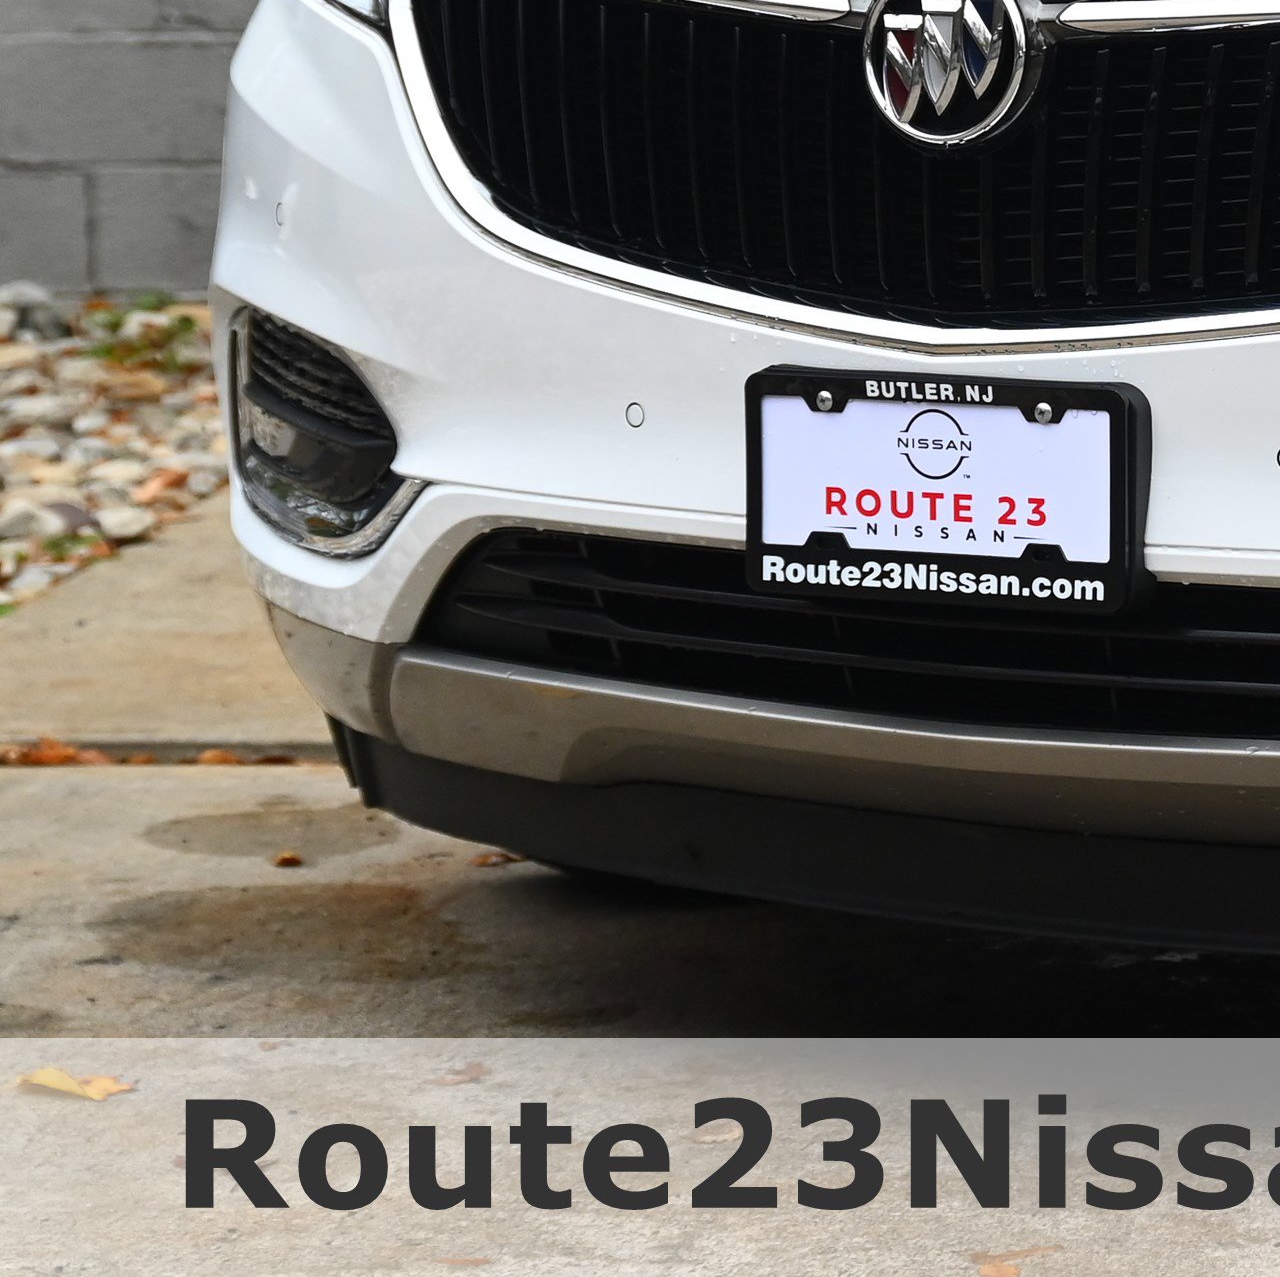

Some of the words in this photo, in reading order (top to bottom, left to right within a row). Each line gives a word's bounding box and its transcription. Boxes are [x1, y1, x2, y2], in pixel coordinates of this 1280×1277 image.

[865, 380, 961, 403] BUTLER,
[965, 384, 994, 403] NJ
[897, 437, 972, 452] NISSAN
[825, 486, 974, 523] ROUTE
[998, 496, 1047, 526] 23
[866, 522, 1005, 543] NISSAN
[762, 555, 1105, 601] Route23Nissan.com
